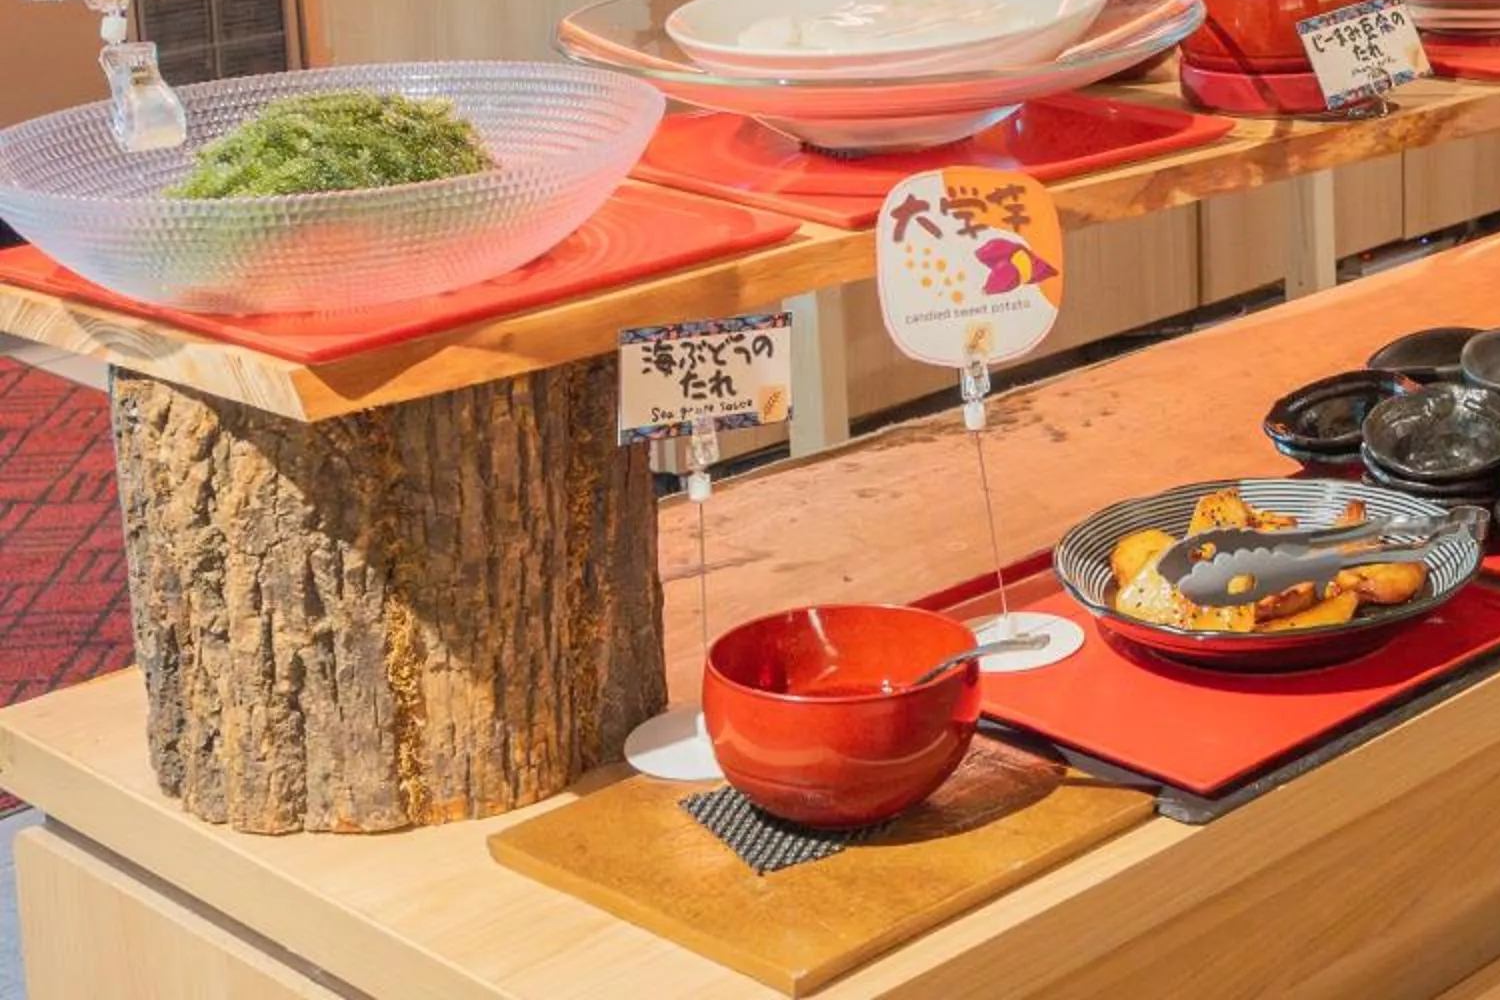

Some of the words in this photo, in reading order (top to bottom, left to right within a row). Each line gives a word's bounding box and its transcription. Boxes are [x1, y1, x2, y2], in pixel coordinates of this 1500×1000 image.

[904, 308, 951, 326] candied
[953, 304, 988, 319] sweet
[990, 298, 1031, 314] potato
[641, 333, 774, 378] 海ぶどうの
[679, 369, 737, 400] たれ
[651, 407, 674, 423] Sea
